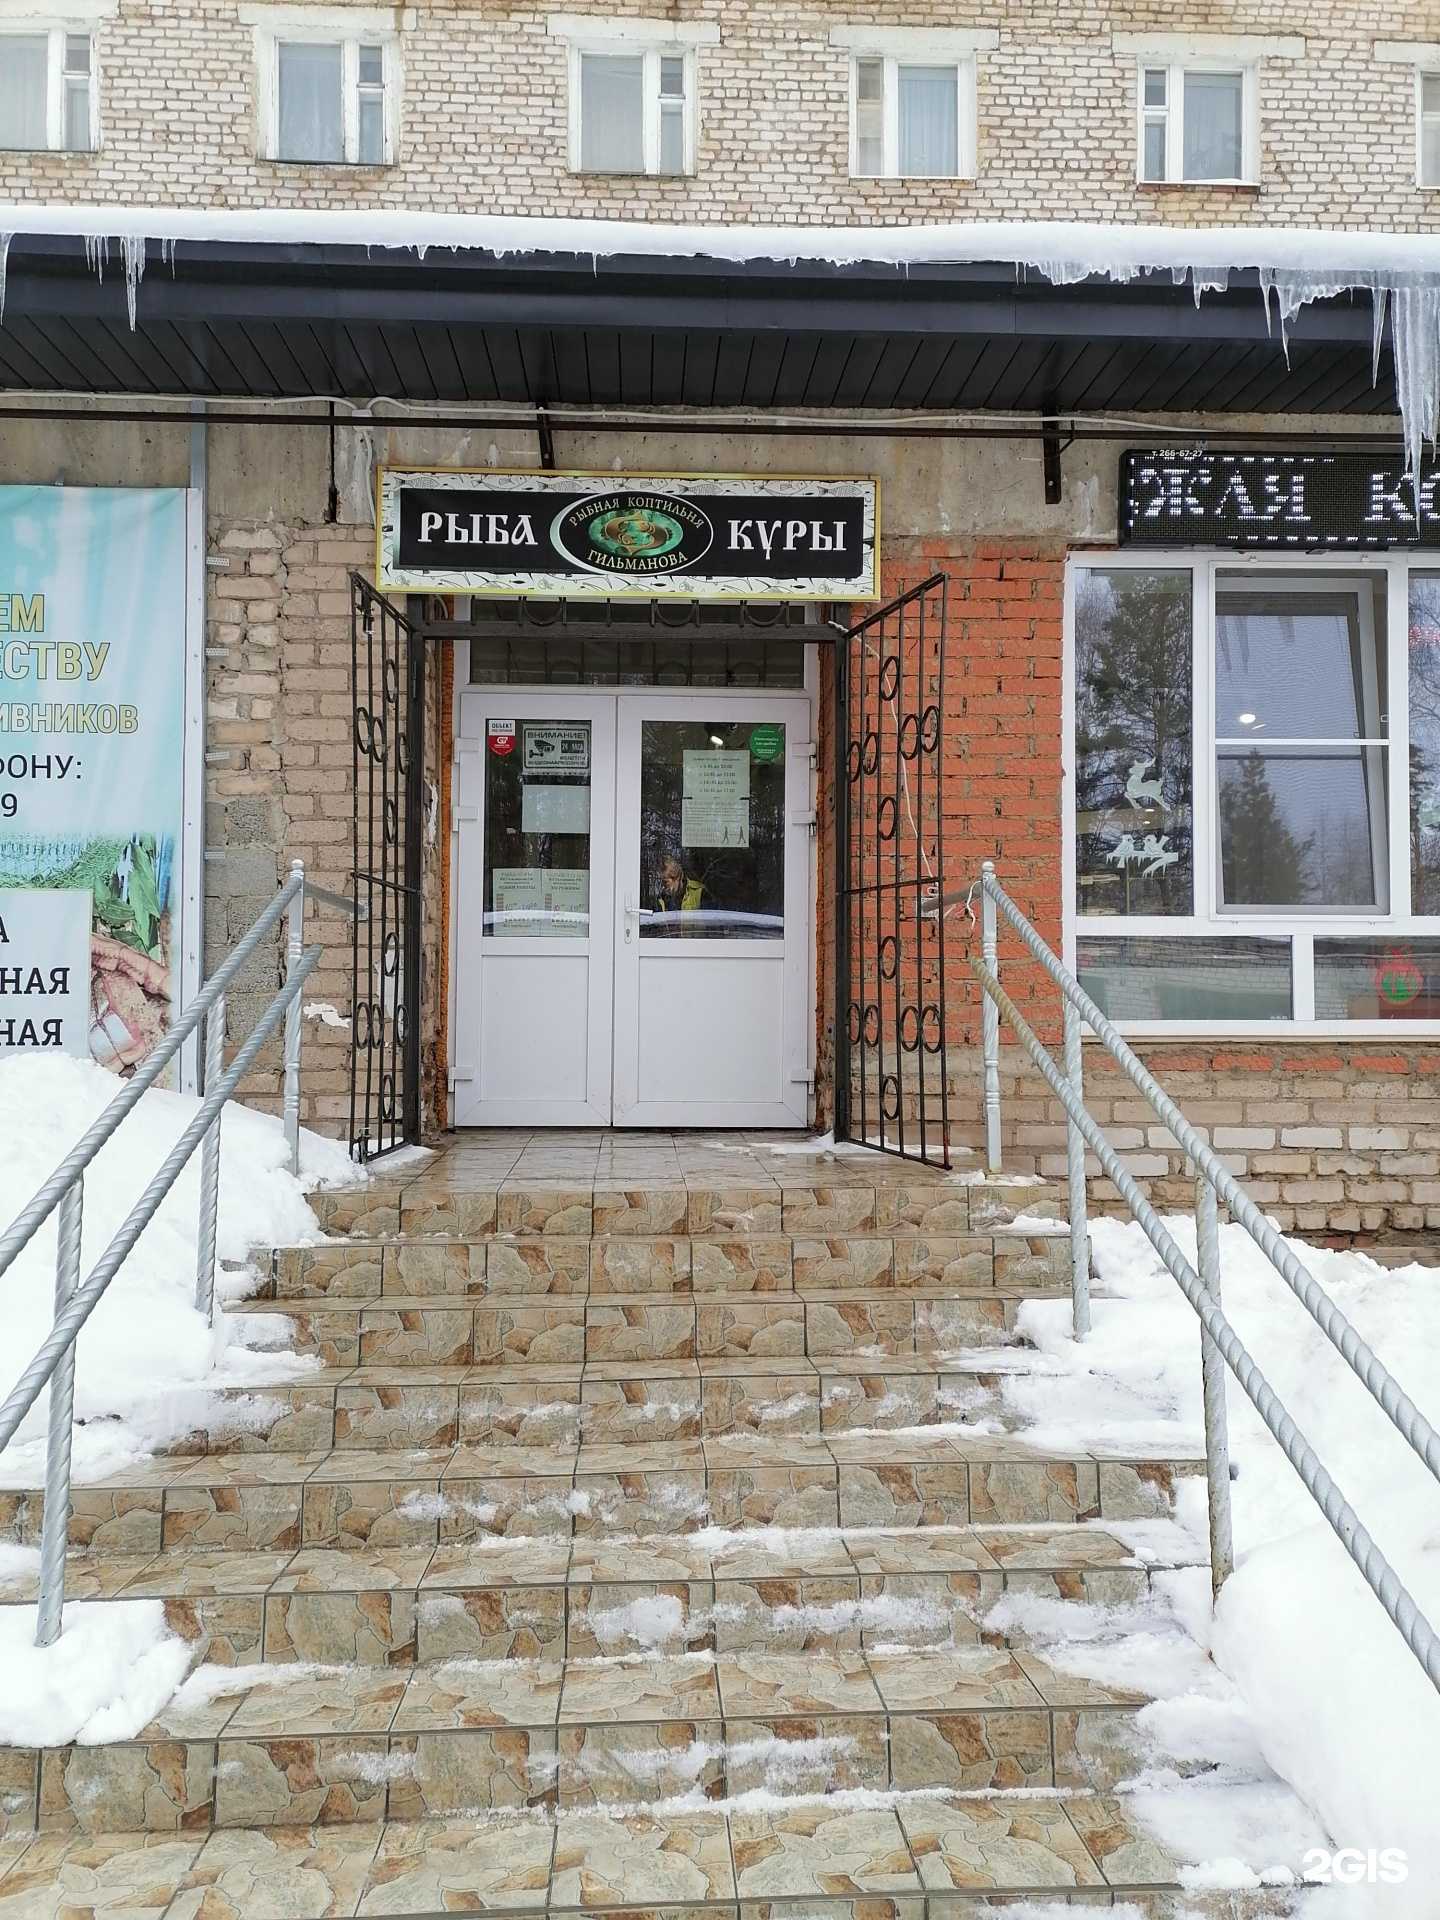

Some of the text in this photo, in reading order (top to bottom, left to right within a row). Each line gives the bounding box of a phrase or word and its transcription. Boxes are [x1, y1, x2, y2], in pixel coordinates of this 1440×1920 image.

[1159, 449, 1203, 457] 266-67-27
[417, 511, 539, 546] РЫБА
[569, 496, 705, 529] РЫБНАЯ КОПТИЛЬНЯ
[727, 519, 847, 560] КУРЫ
[587, 549, 689, 570] ГИЛЬМАНОВА
[0, 641, 111, 681] СТВУ
[0, 754, 82, 779] ОНУ:
